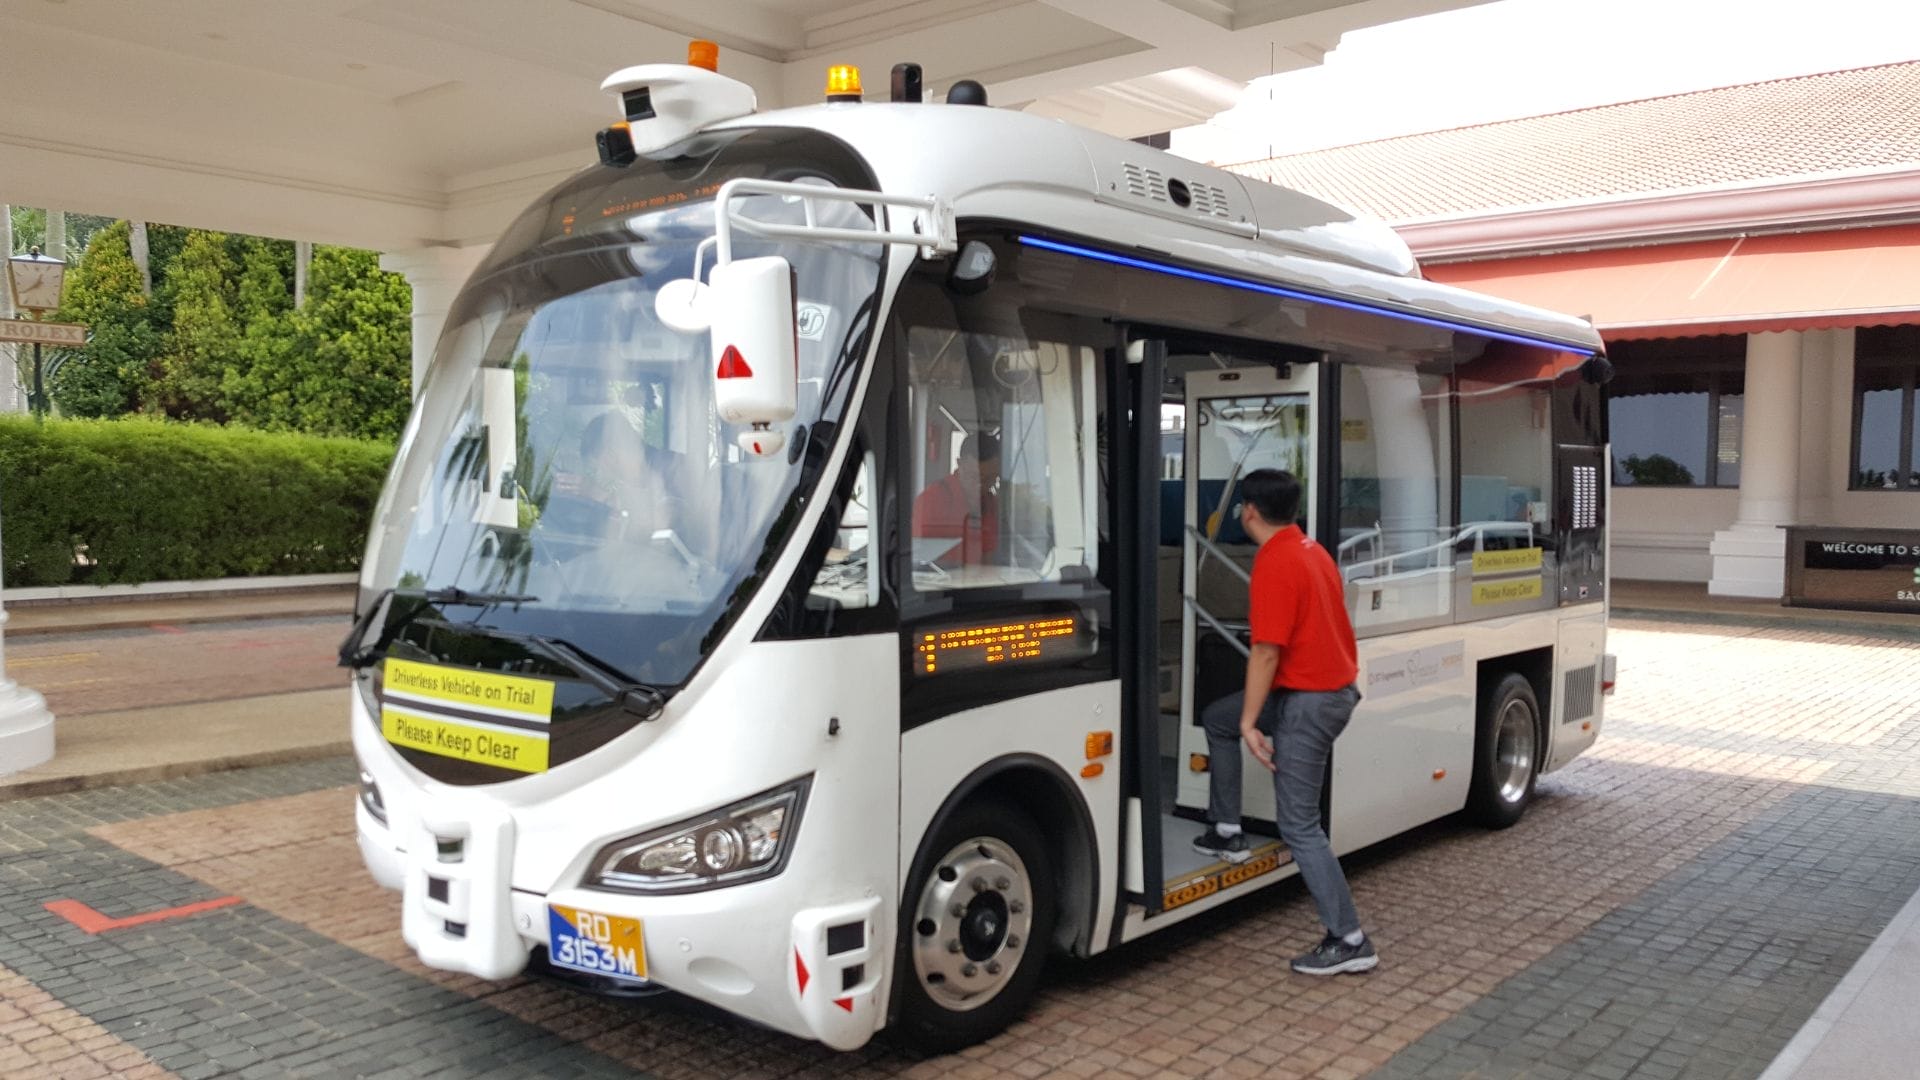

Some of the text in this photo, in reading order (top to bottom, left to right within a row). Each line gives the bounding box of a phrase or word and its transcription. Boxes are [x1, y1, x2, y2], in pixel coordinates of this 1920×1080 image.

[4, 323, 77, 339] ROLEX
[1822, 543, 1920, 555] WELCOME TO S
[394, 668, 536, 705] Driverless Vehicle on Trial
[396, 719, 520, 761] Please Keep Clear
[576, 910, 611, 943] RD
[557, 933, 638, 975] 3153M
